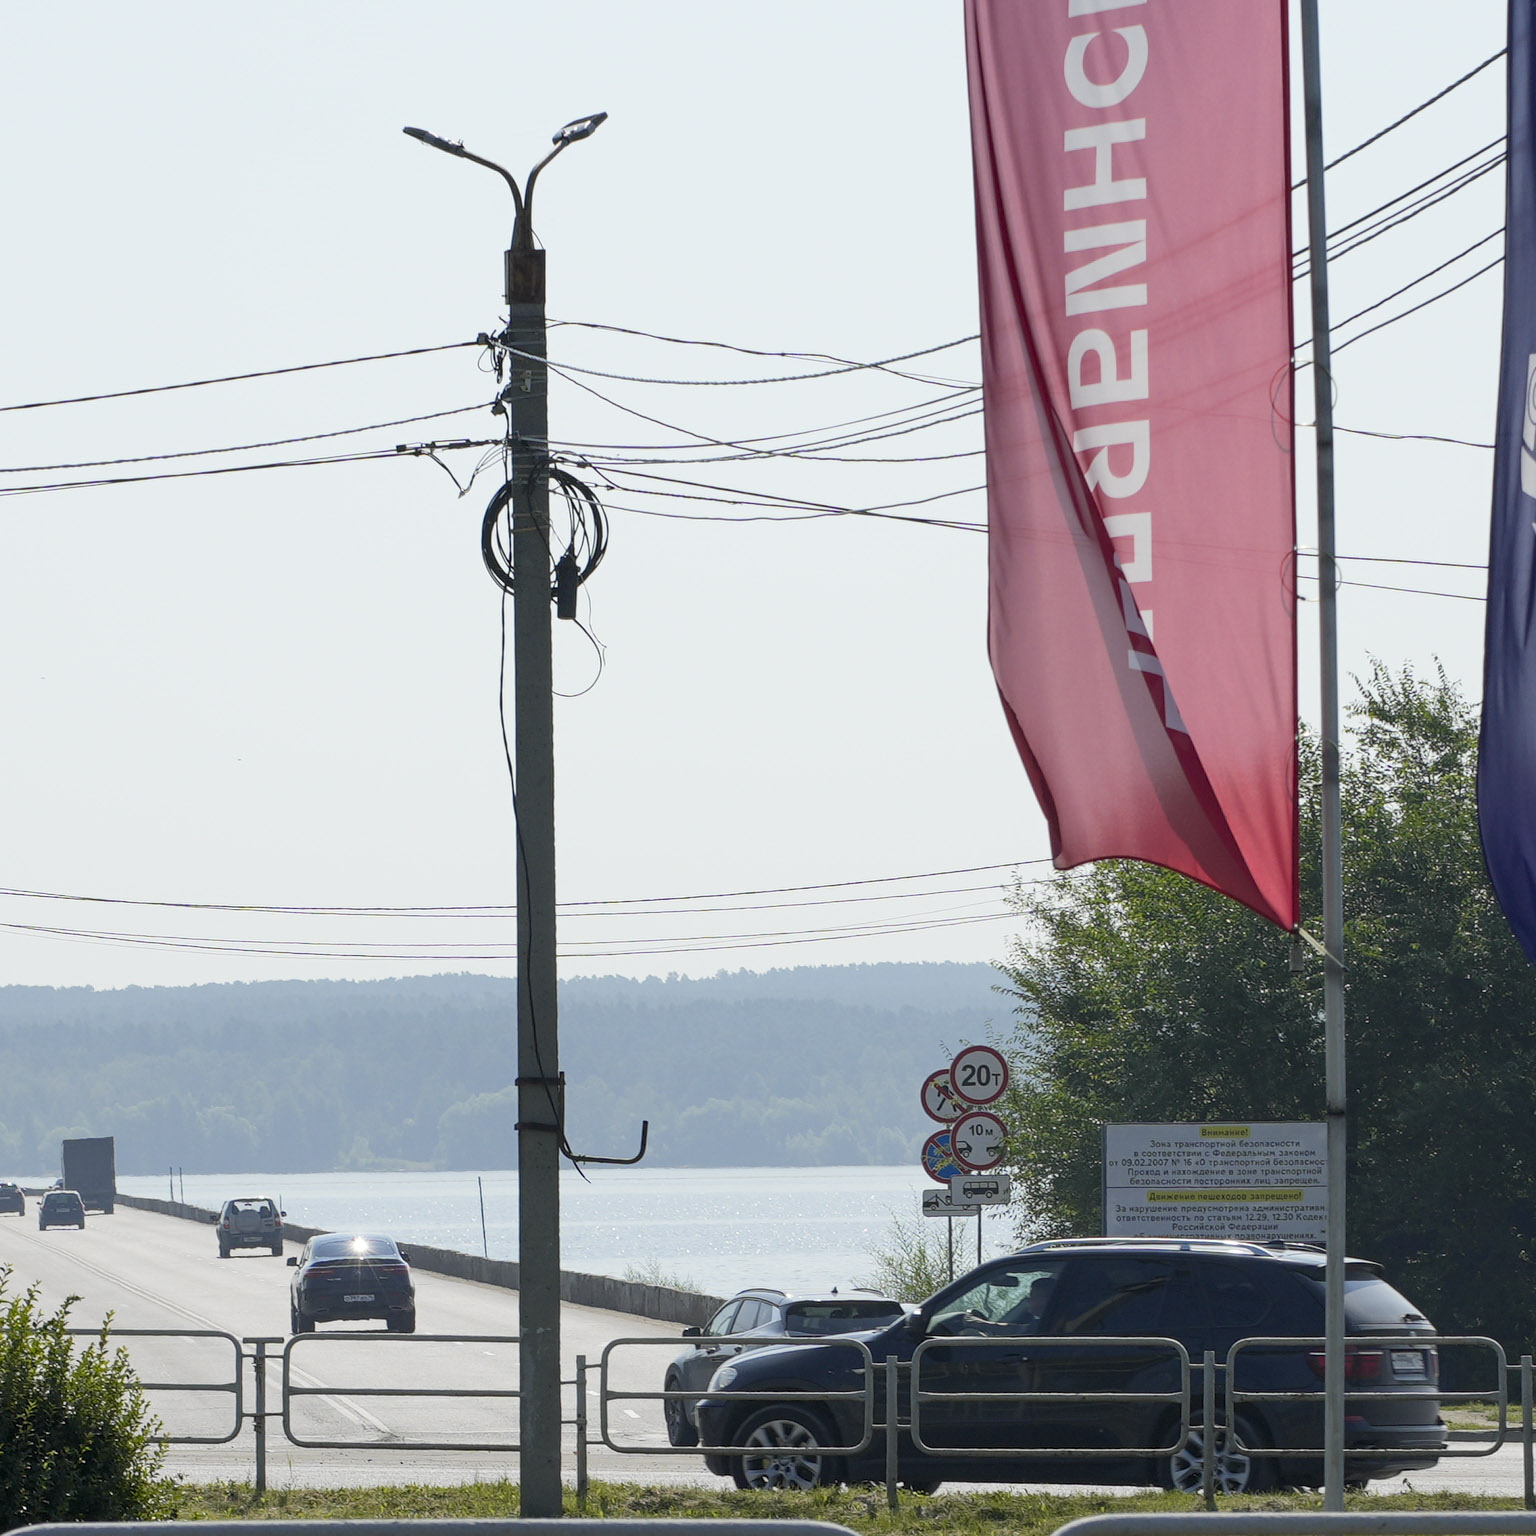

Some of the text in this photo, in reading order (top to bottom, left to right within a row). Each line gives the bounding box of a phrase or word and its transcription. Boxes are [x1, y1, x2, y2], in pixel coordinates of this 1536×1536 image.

[1201, 1128, 1249, 1136] Внимание!
[1150, 1140, 1300, 1149] Зона транспортной безопасности
[1213, 1150, 1275, 1158] Федеральным
[1209, 1159, 1271, 1168] транспортной
[1128, 1168, 1161, 1177] Проход
[1261, 1167, 1322, 1177] транспортной
[1130, 1178, 1191, 1186] безопасности
[1194, 1178, 1251, 1187] посторонних
[1149, 1192, 1195, 1201] Движение
[1250, 1191, 1302, 1201] запрещено!
[1181, 1205, 1249, 1213] предусмотрена
[1252, 1204, 1327, 1212] административн
[1172, 1222, 1278, 1231] Российской Федерации
